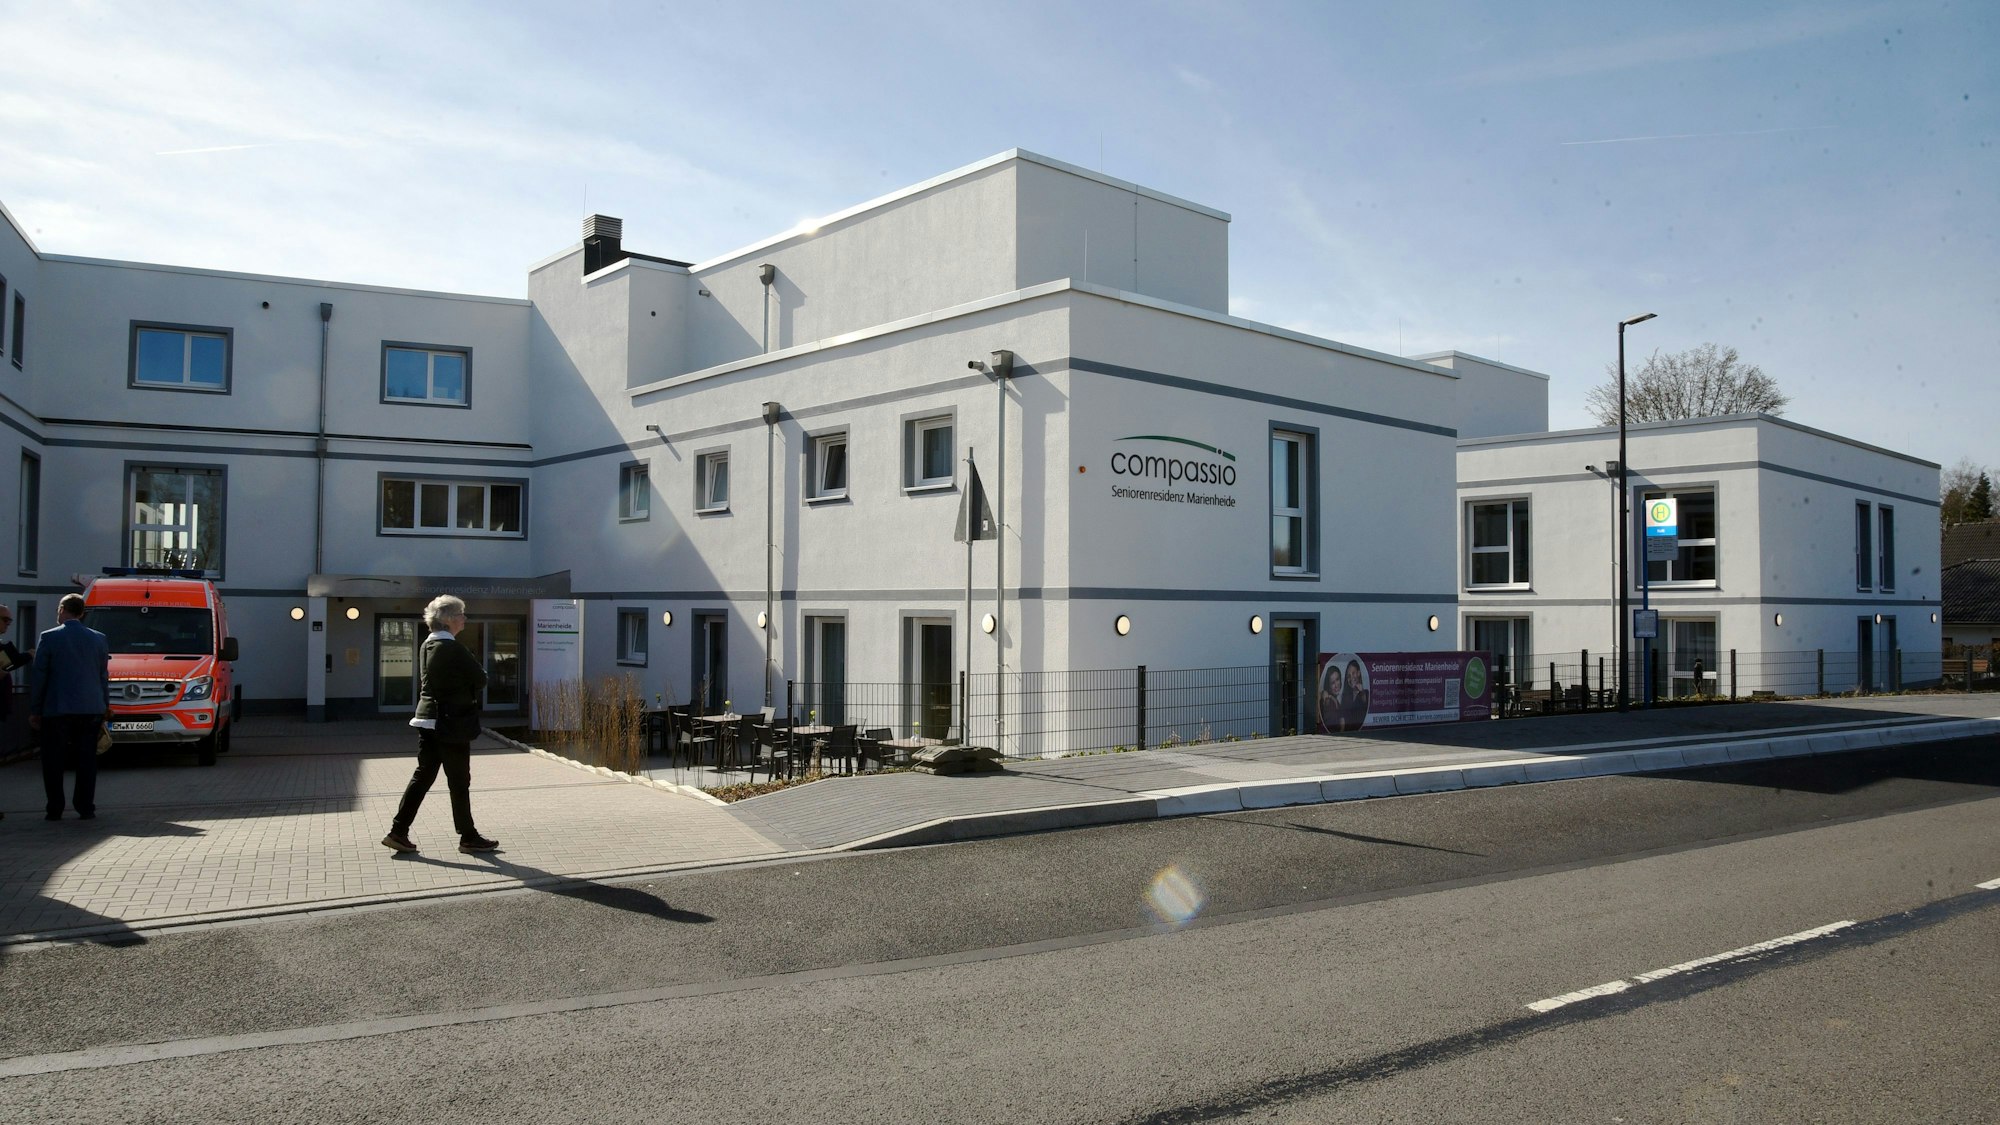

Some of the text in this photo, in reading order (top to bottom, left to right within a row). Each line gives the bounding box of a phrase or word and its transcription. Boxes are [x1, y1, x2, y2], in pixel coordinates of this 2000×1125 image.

[1111, 449, 1236, 486] compassio
[1112, 485, 1236, 507] Seniorenresidenz Marienheide
[412, 584, 489, 595] eniorenresidenz
[491, 585, 546, 595] Marienheide
[1371, 661, 1459, 673] Seniorenresidenz Marienheide
